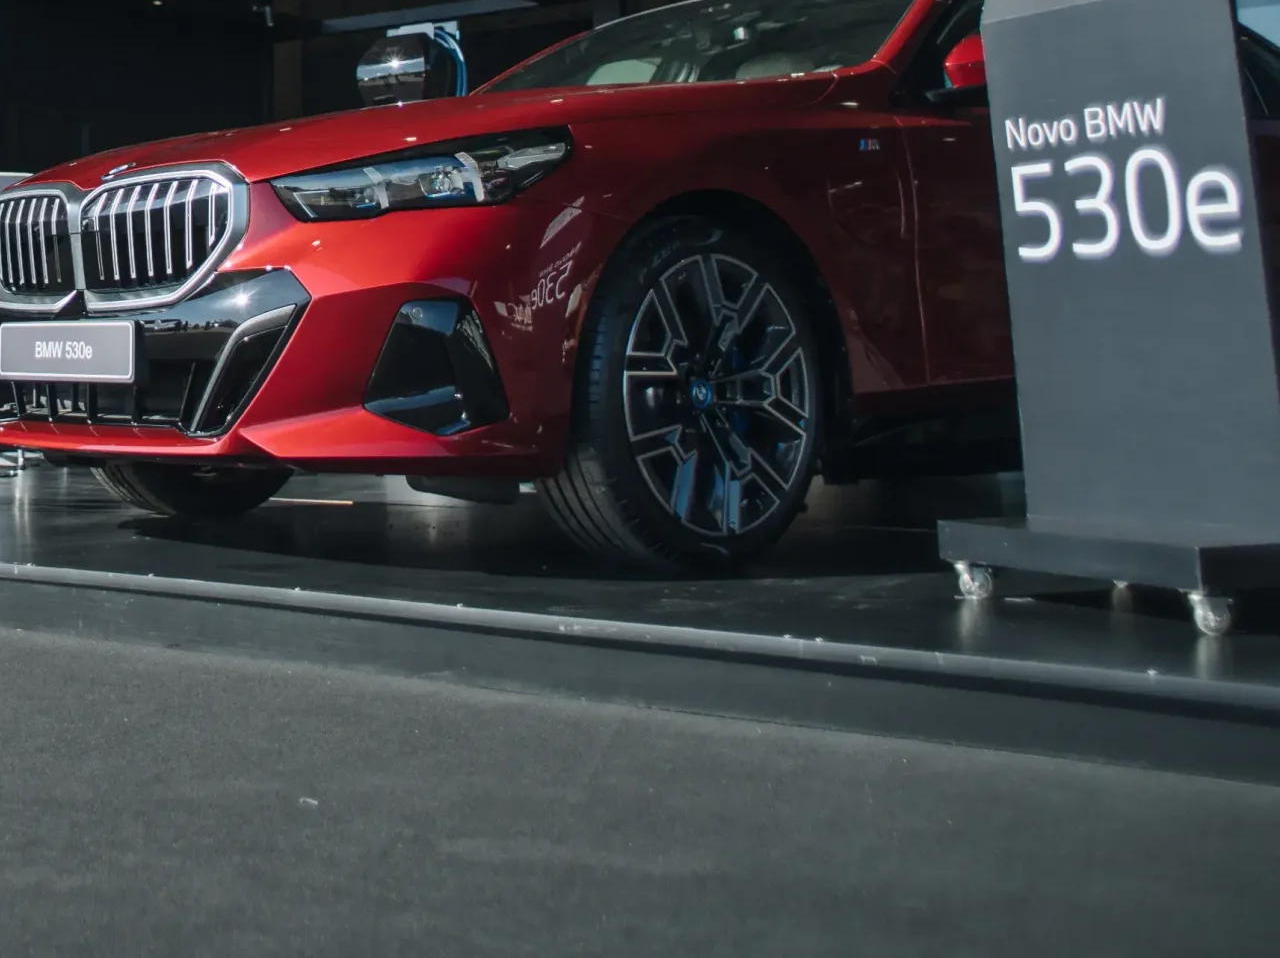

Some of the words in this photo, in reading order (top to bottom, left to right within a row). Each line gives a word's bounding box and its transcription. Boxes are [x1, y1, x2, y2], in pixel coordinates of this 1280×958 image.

[1004, 117, 1078, 151] Novo
[1083, 97, 1167, 140] BMW
[1011, 148, 1243, 260] 530e
[35, 341, 63, 359] BMW
[65, 341, 93, 360] 530e
